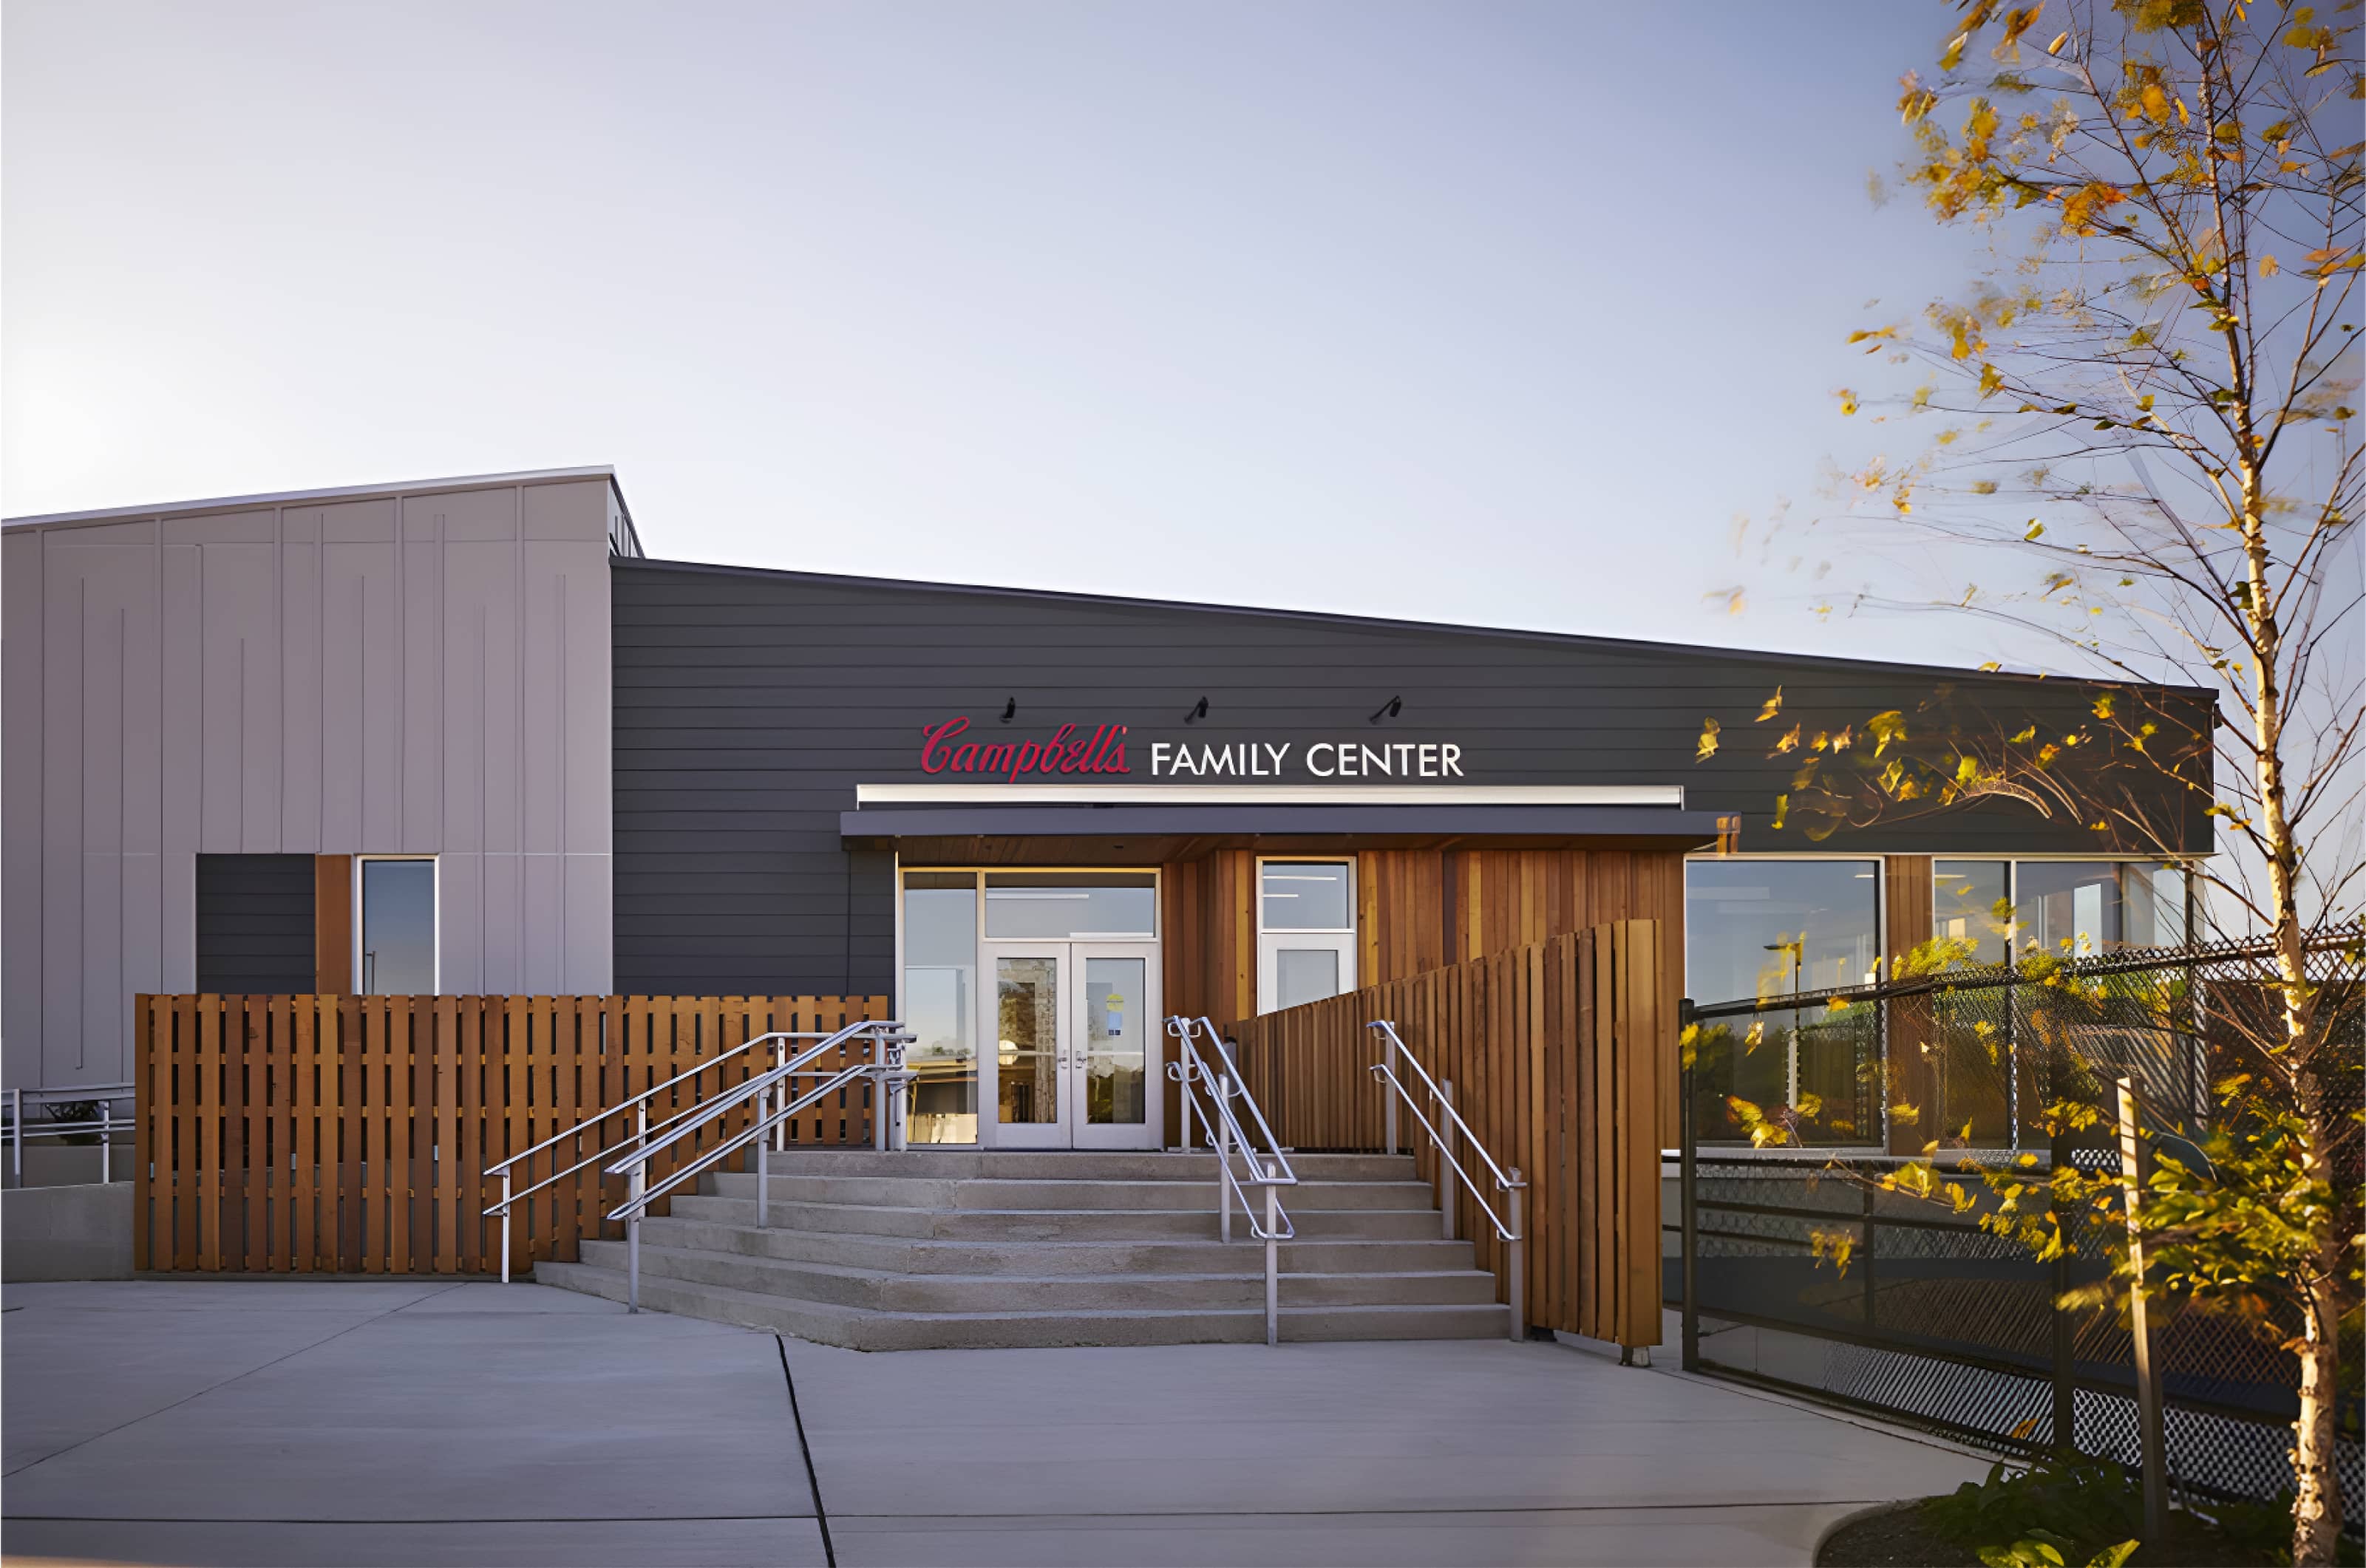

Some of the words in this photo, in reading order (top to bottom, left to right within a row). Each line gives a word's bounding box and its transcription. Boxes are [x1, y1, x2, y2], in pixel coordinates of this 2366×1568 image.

[921, 715, 1131, 784] Campbell's
[1151, 743, 1291, 777] FAMILY
[1306, 742, 1465, 777] CENTER
